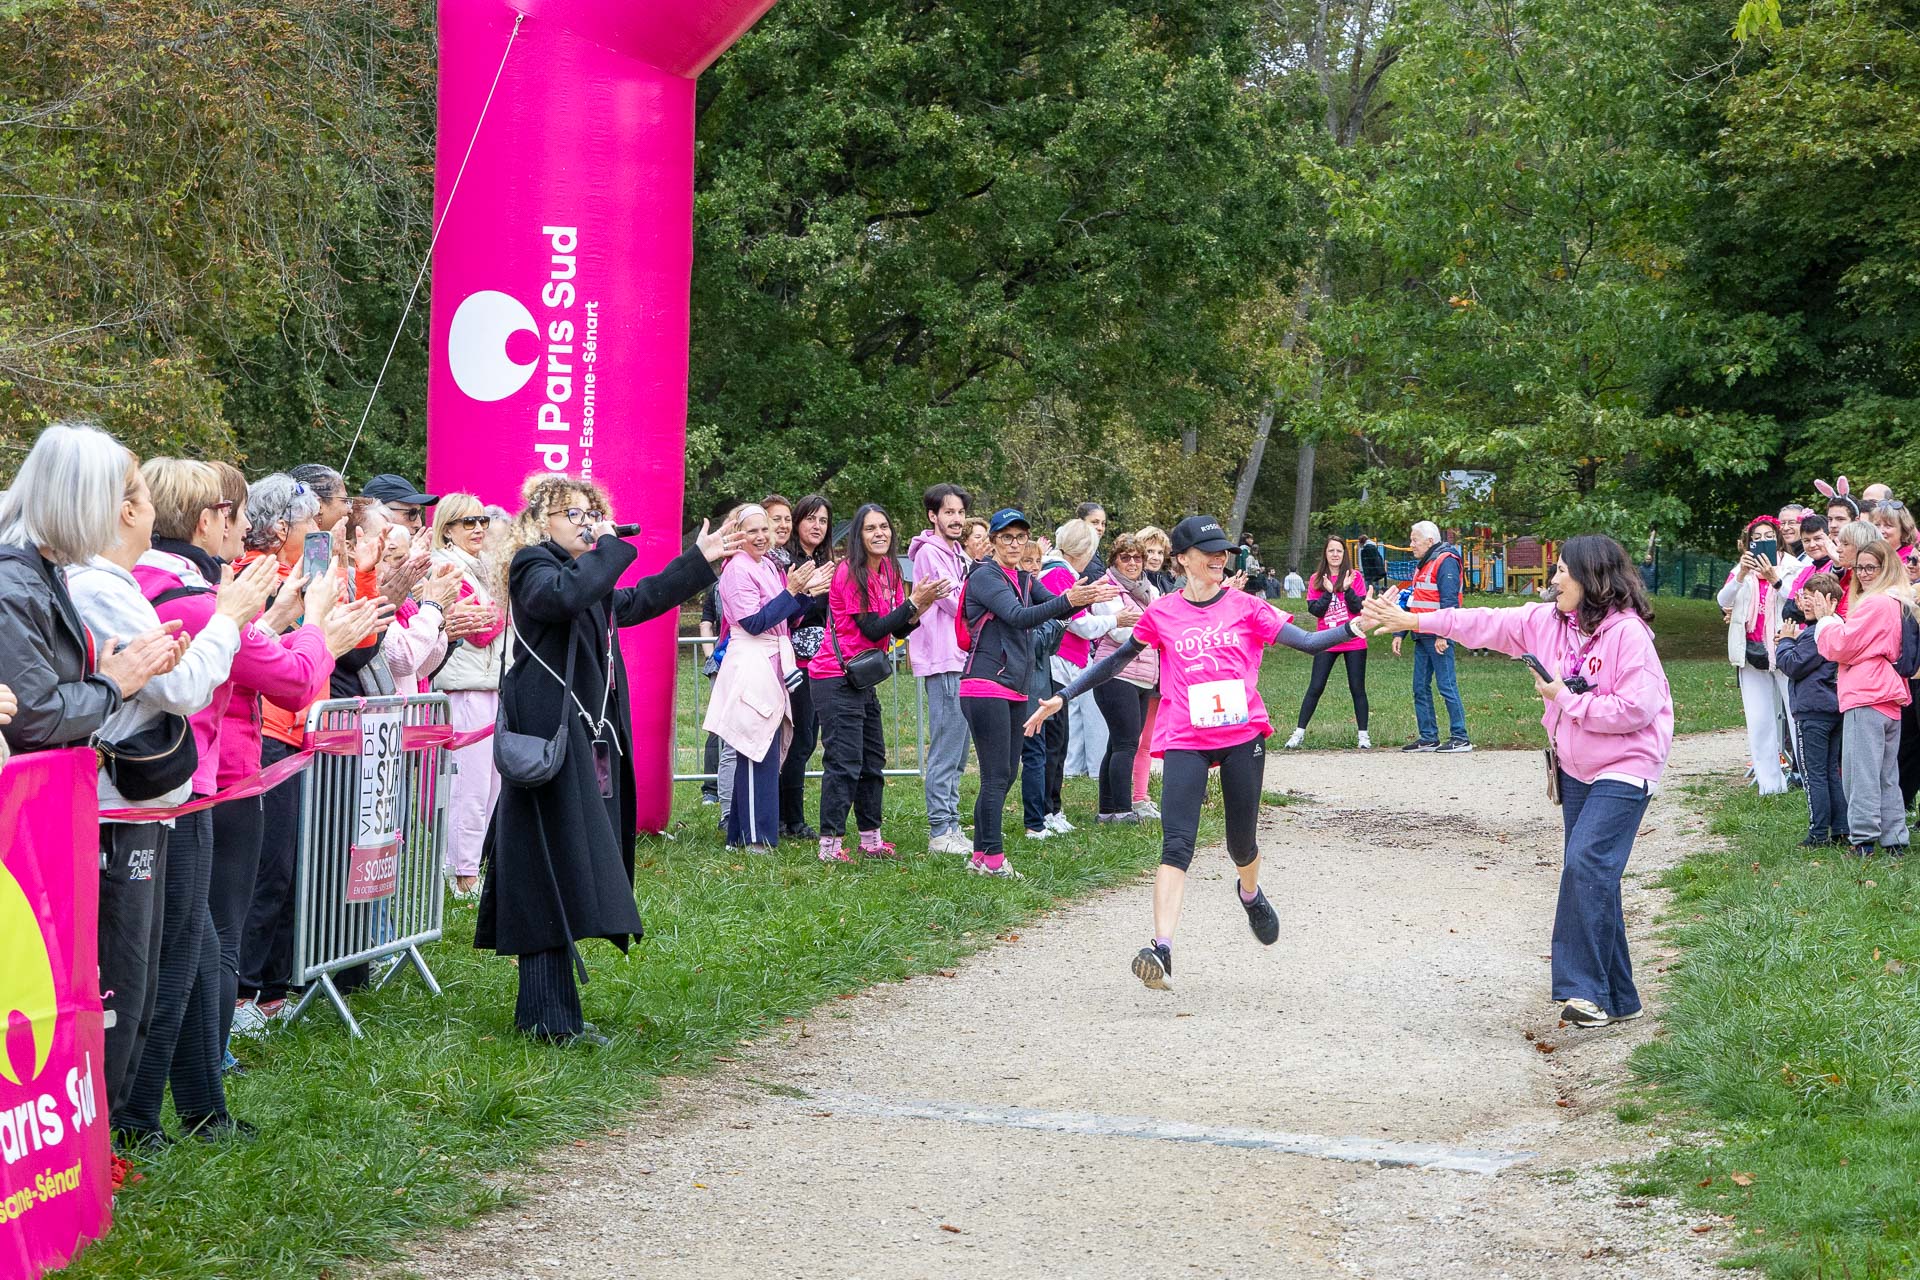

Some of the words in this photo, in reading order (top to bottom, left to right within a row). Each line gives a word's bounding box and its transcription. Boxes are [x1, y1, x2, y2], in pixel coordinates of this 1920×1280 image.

[542, 225, 577, 309] Sud
[538, 320, 574, 431] Paris
[579, 301, 599, 483] ne-Essonne-Sénart
[1174, 631, 1240, 653] ODYSSEA
[1212, 694, 1225, 713] 1
[363, 722, 375, 756] DE
[361, 767, 374, 836] VILLE
